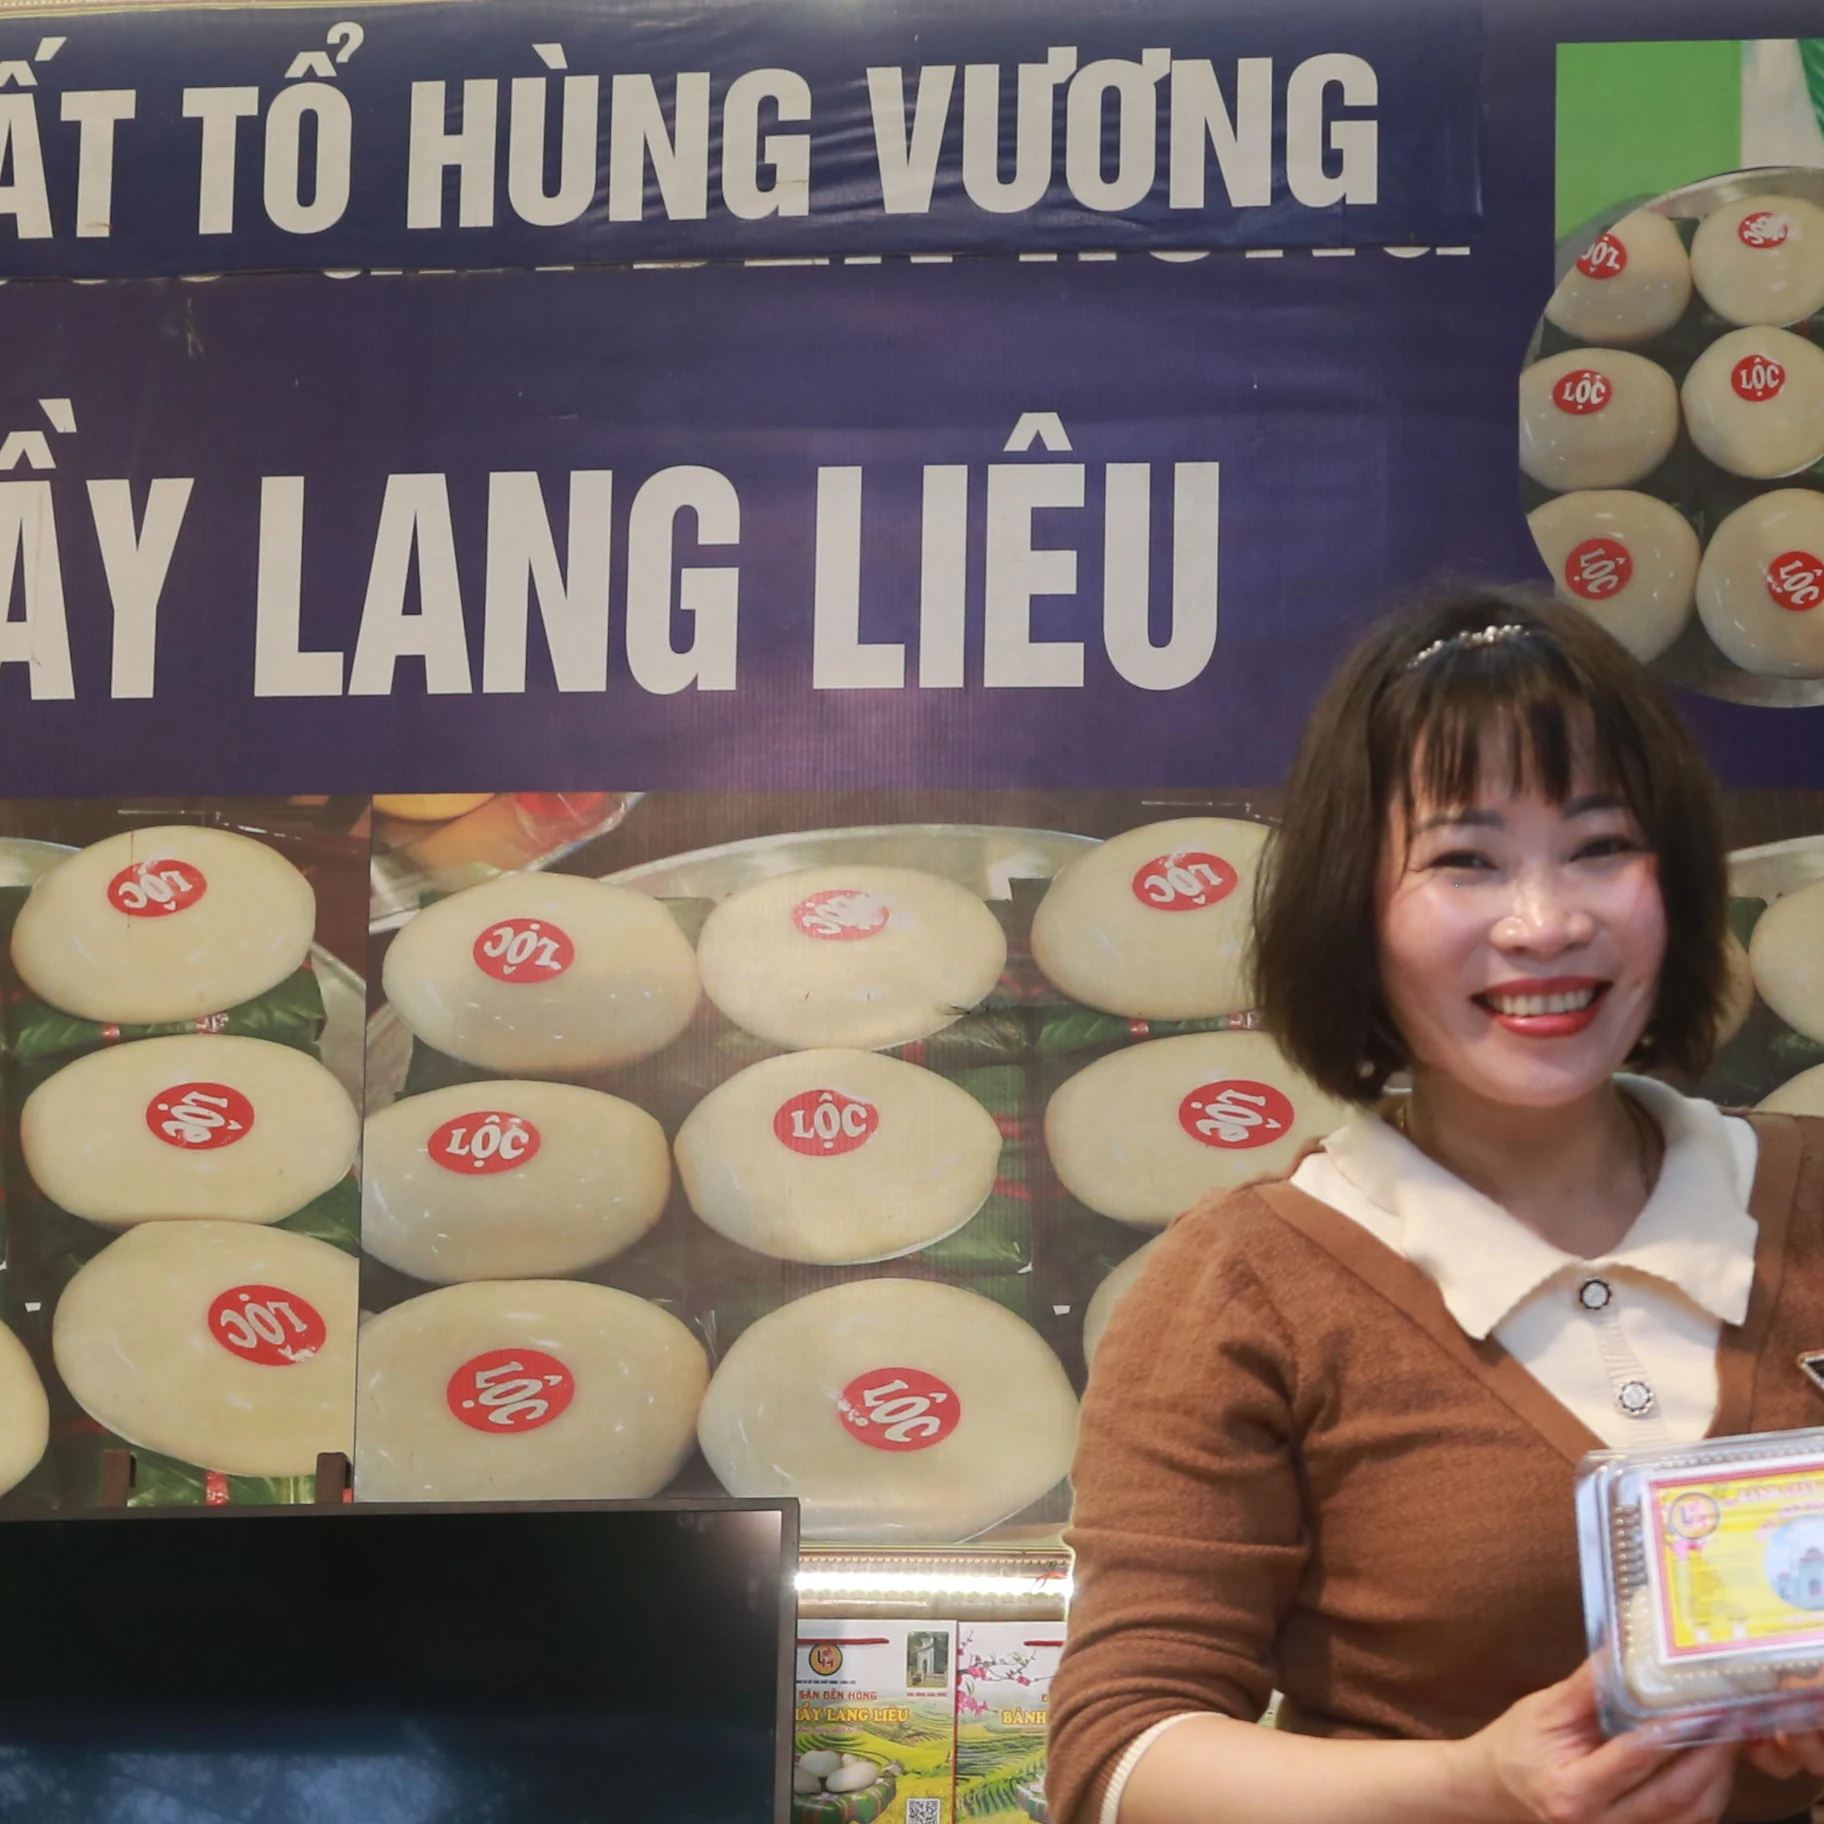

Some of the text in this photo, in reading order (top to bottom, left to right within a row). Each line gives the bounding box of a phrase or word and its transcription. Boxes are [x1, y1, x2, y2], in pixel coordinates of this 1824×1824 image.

[183, 22, 364, 234] TỔ
[407, 43, 811, 229] HÙNG
[866, 46, 1377, 214] VƯƠNG
[1740, 355, 1780, 397] LỘC
[254, 465, 740, 705] LANG
[808, 412, 1219, 700] LIÊU
[1769, 560, 1823, 605] LỘC
[118, 862, 194, 915] LỘC
[482, 922, 564, 980] LỘC
[445, 1111, 530, 1168] LỘC
[790, 1090, 864, 1150] LỘC
[219, 1293, 316, 1362] LỘC
[462, 1361, 564, 1425] LỘC
[843, 1378, 949, 1443] LỘC
